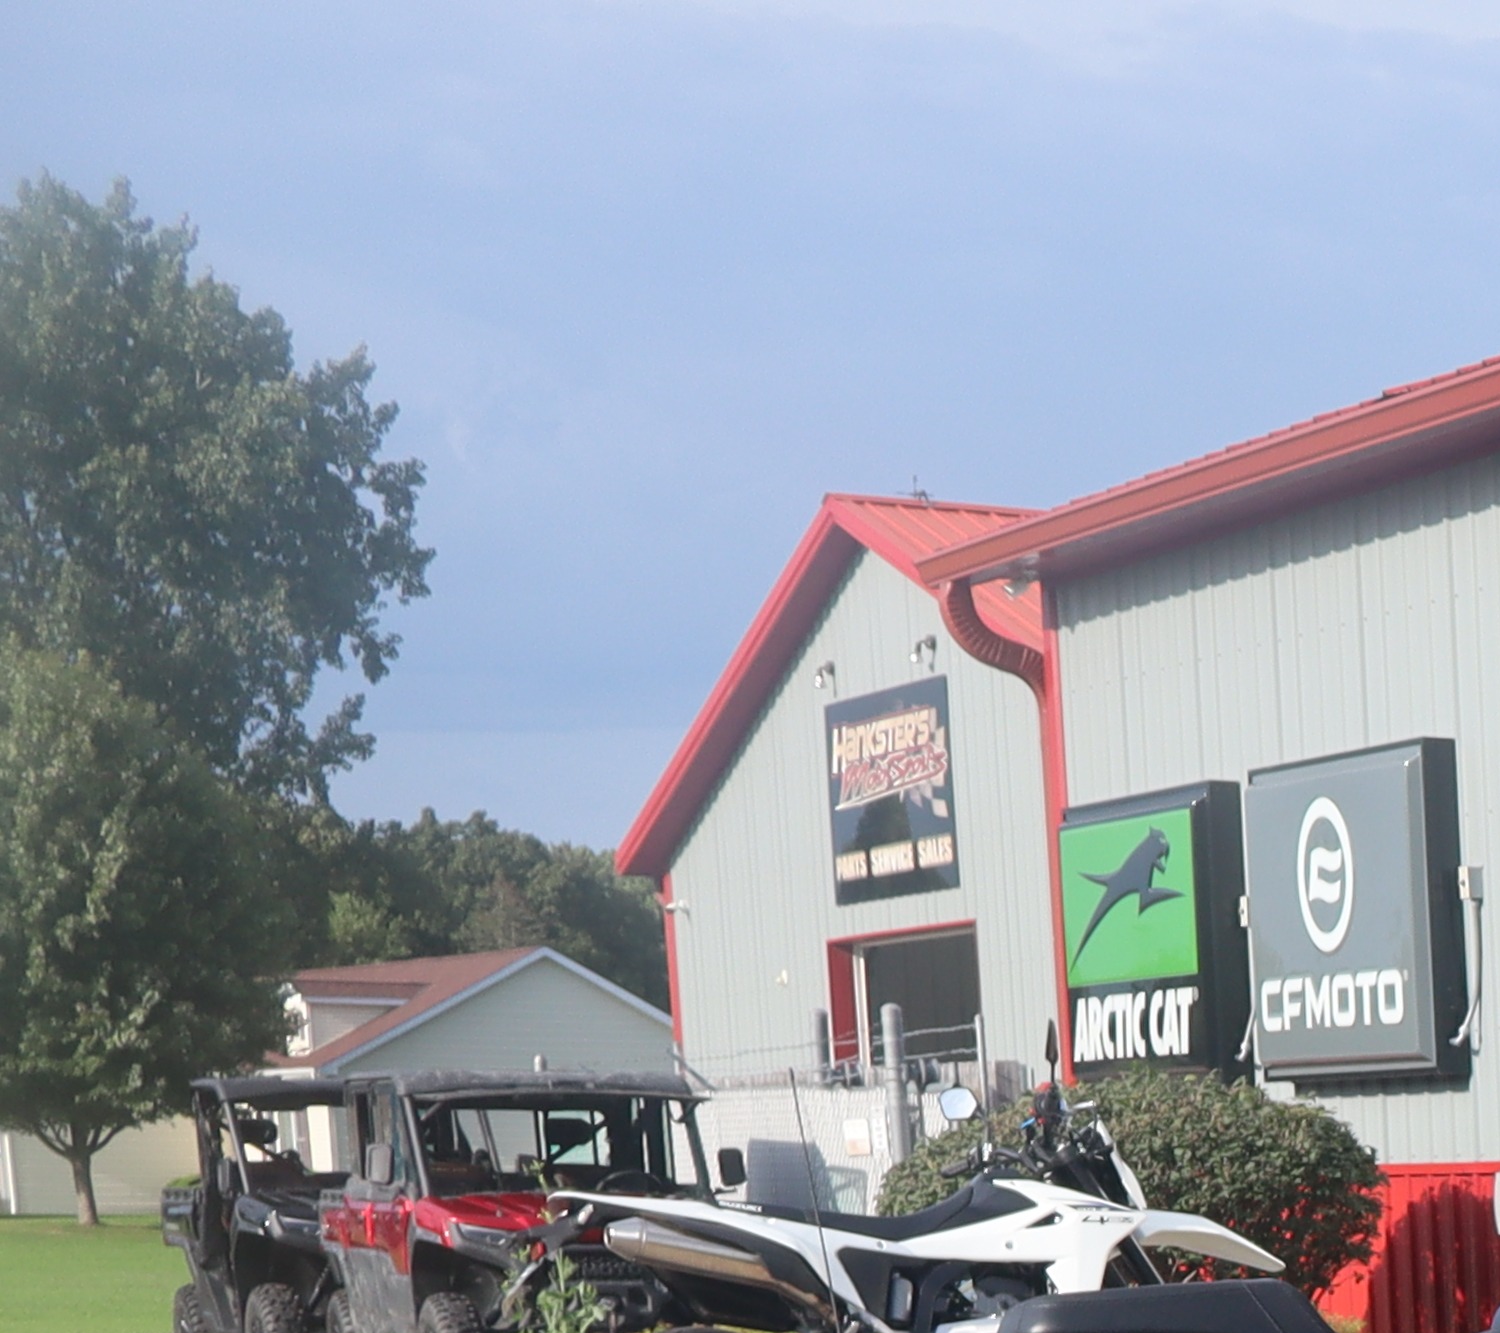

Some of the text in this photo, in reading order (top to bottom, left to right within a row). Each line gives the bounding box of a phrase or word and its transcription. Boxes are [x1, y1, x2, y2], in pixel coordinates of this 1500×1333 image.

[836, 835, 953, 882] PARTS SERVICE SALES
[1073, 986, 1194, 1063] ARCTIC CAT
[1261, 968, 1404, 1032] CFMOTO
